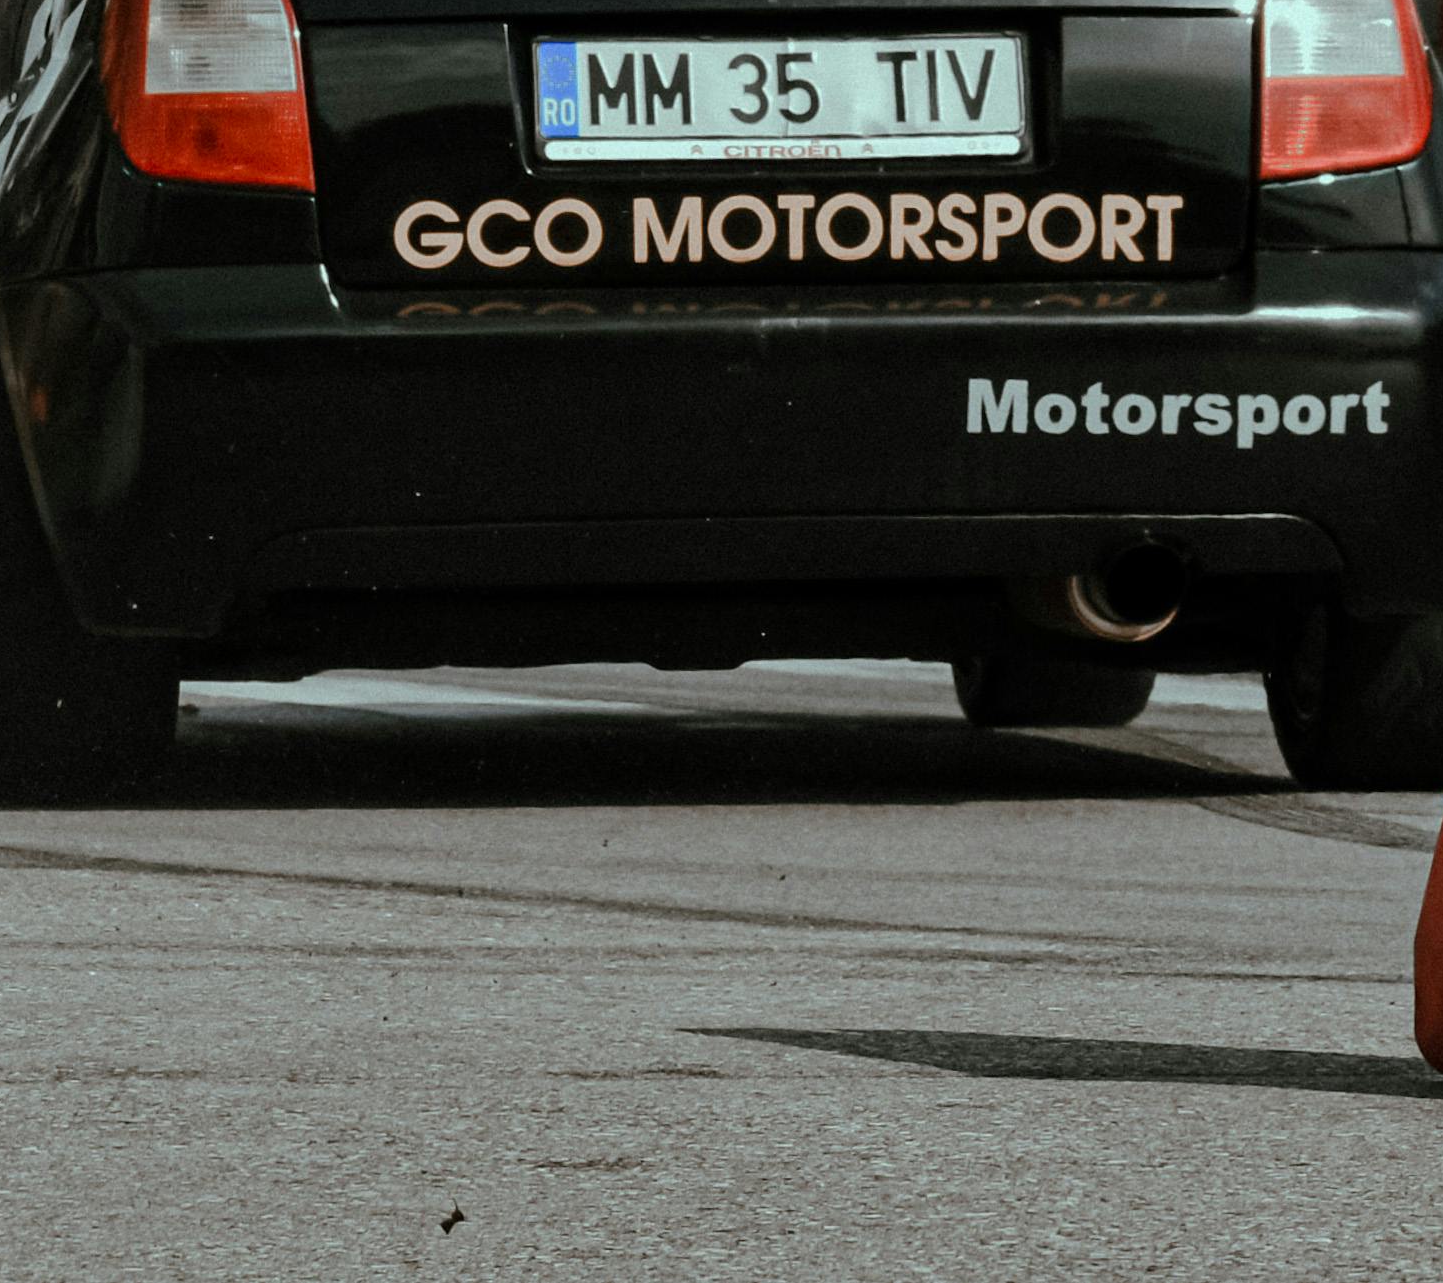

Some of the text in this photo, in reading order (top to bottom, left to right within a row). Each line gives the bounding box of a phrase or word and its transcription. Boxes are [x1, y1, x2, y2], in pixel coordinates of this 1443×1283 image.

[544, 48, 995, 126] RO MM 35 TIV
[393, 191, 1185, 269] GCO MOTORSPORT
[965, 377, 1391, 448] Motorsport
